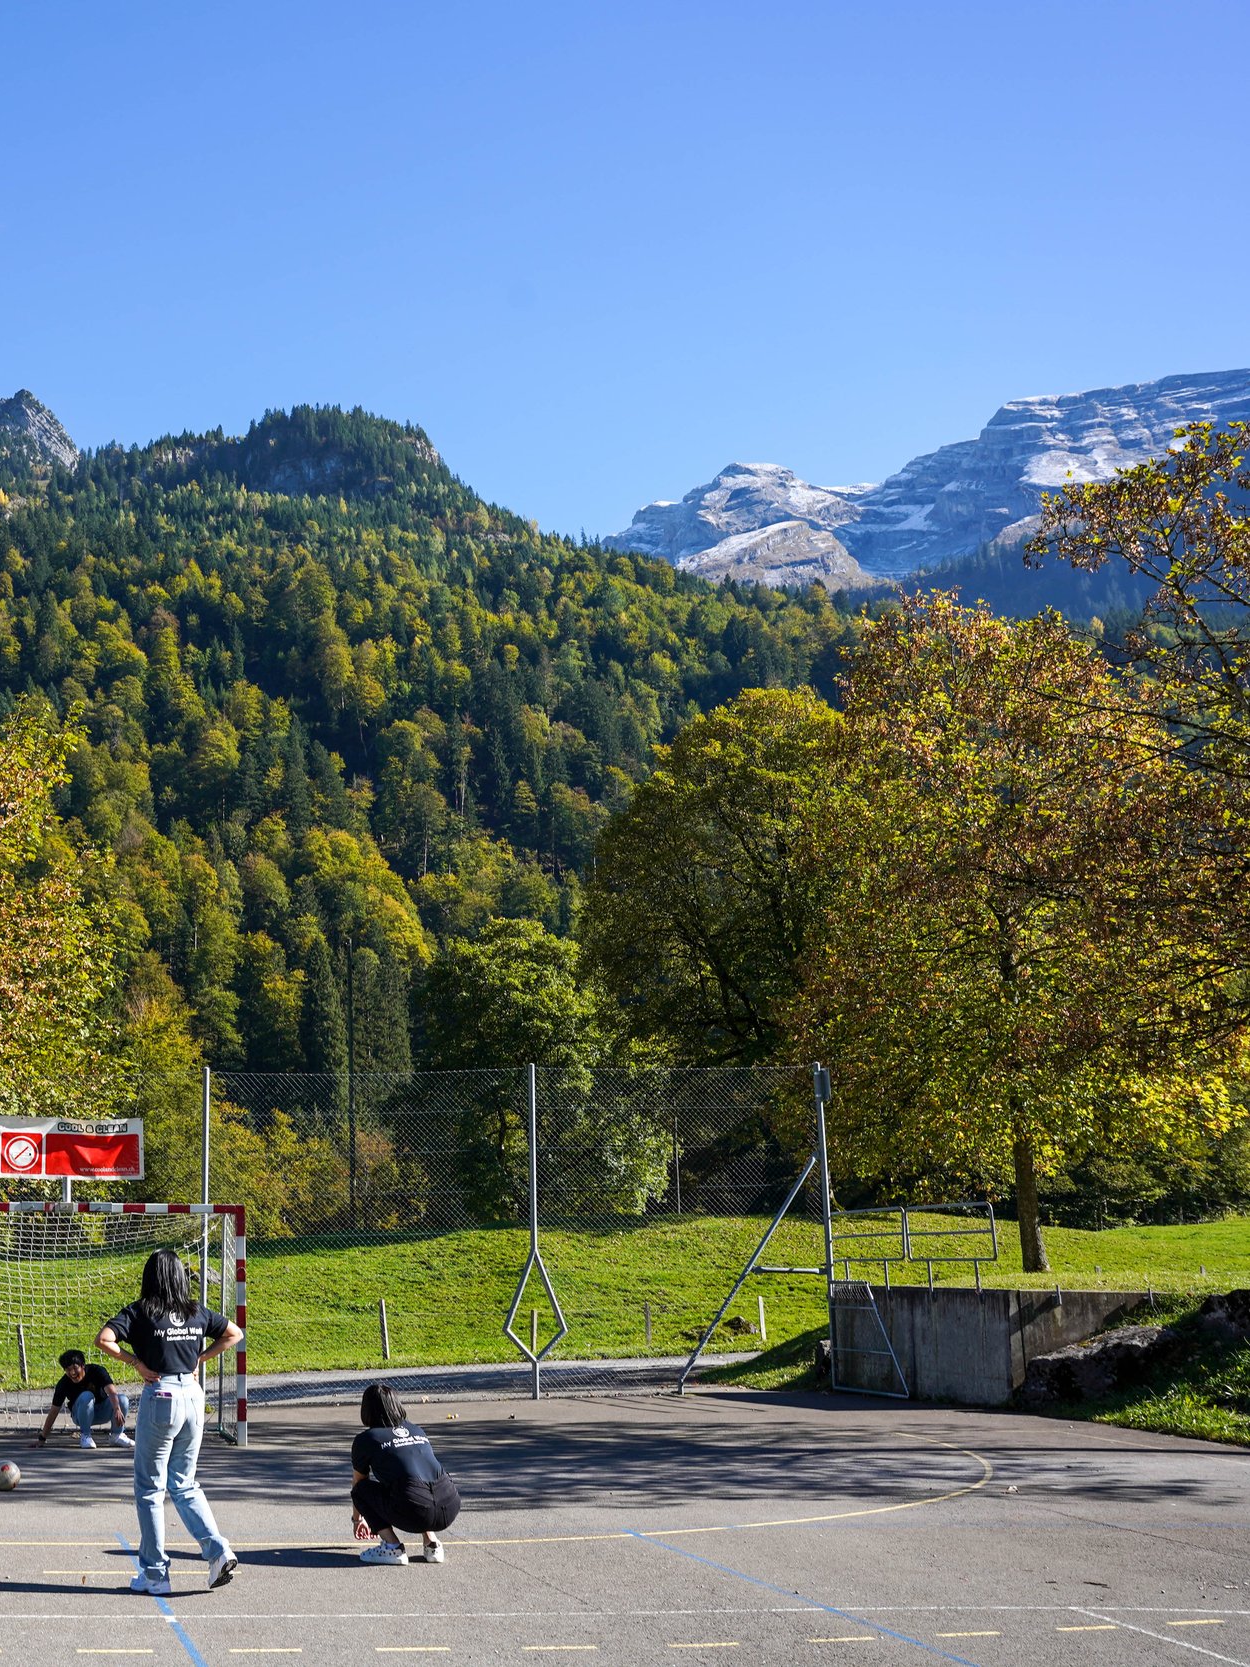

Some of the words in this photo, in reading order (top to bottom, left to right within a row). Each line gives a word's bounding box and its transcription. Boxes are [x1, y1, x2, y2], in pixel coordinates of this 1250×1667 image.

[57, 1122, 84, 1132] COOL
[95, 1123, 128, 1134] CLEAN
[154, 1329, 165, 1338] My
[166, 1327, 189, 1336] Global
